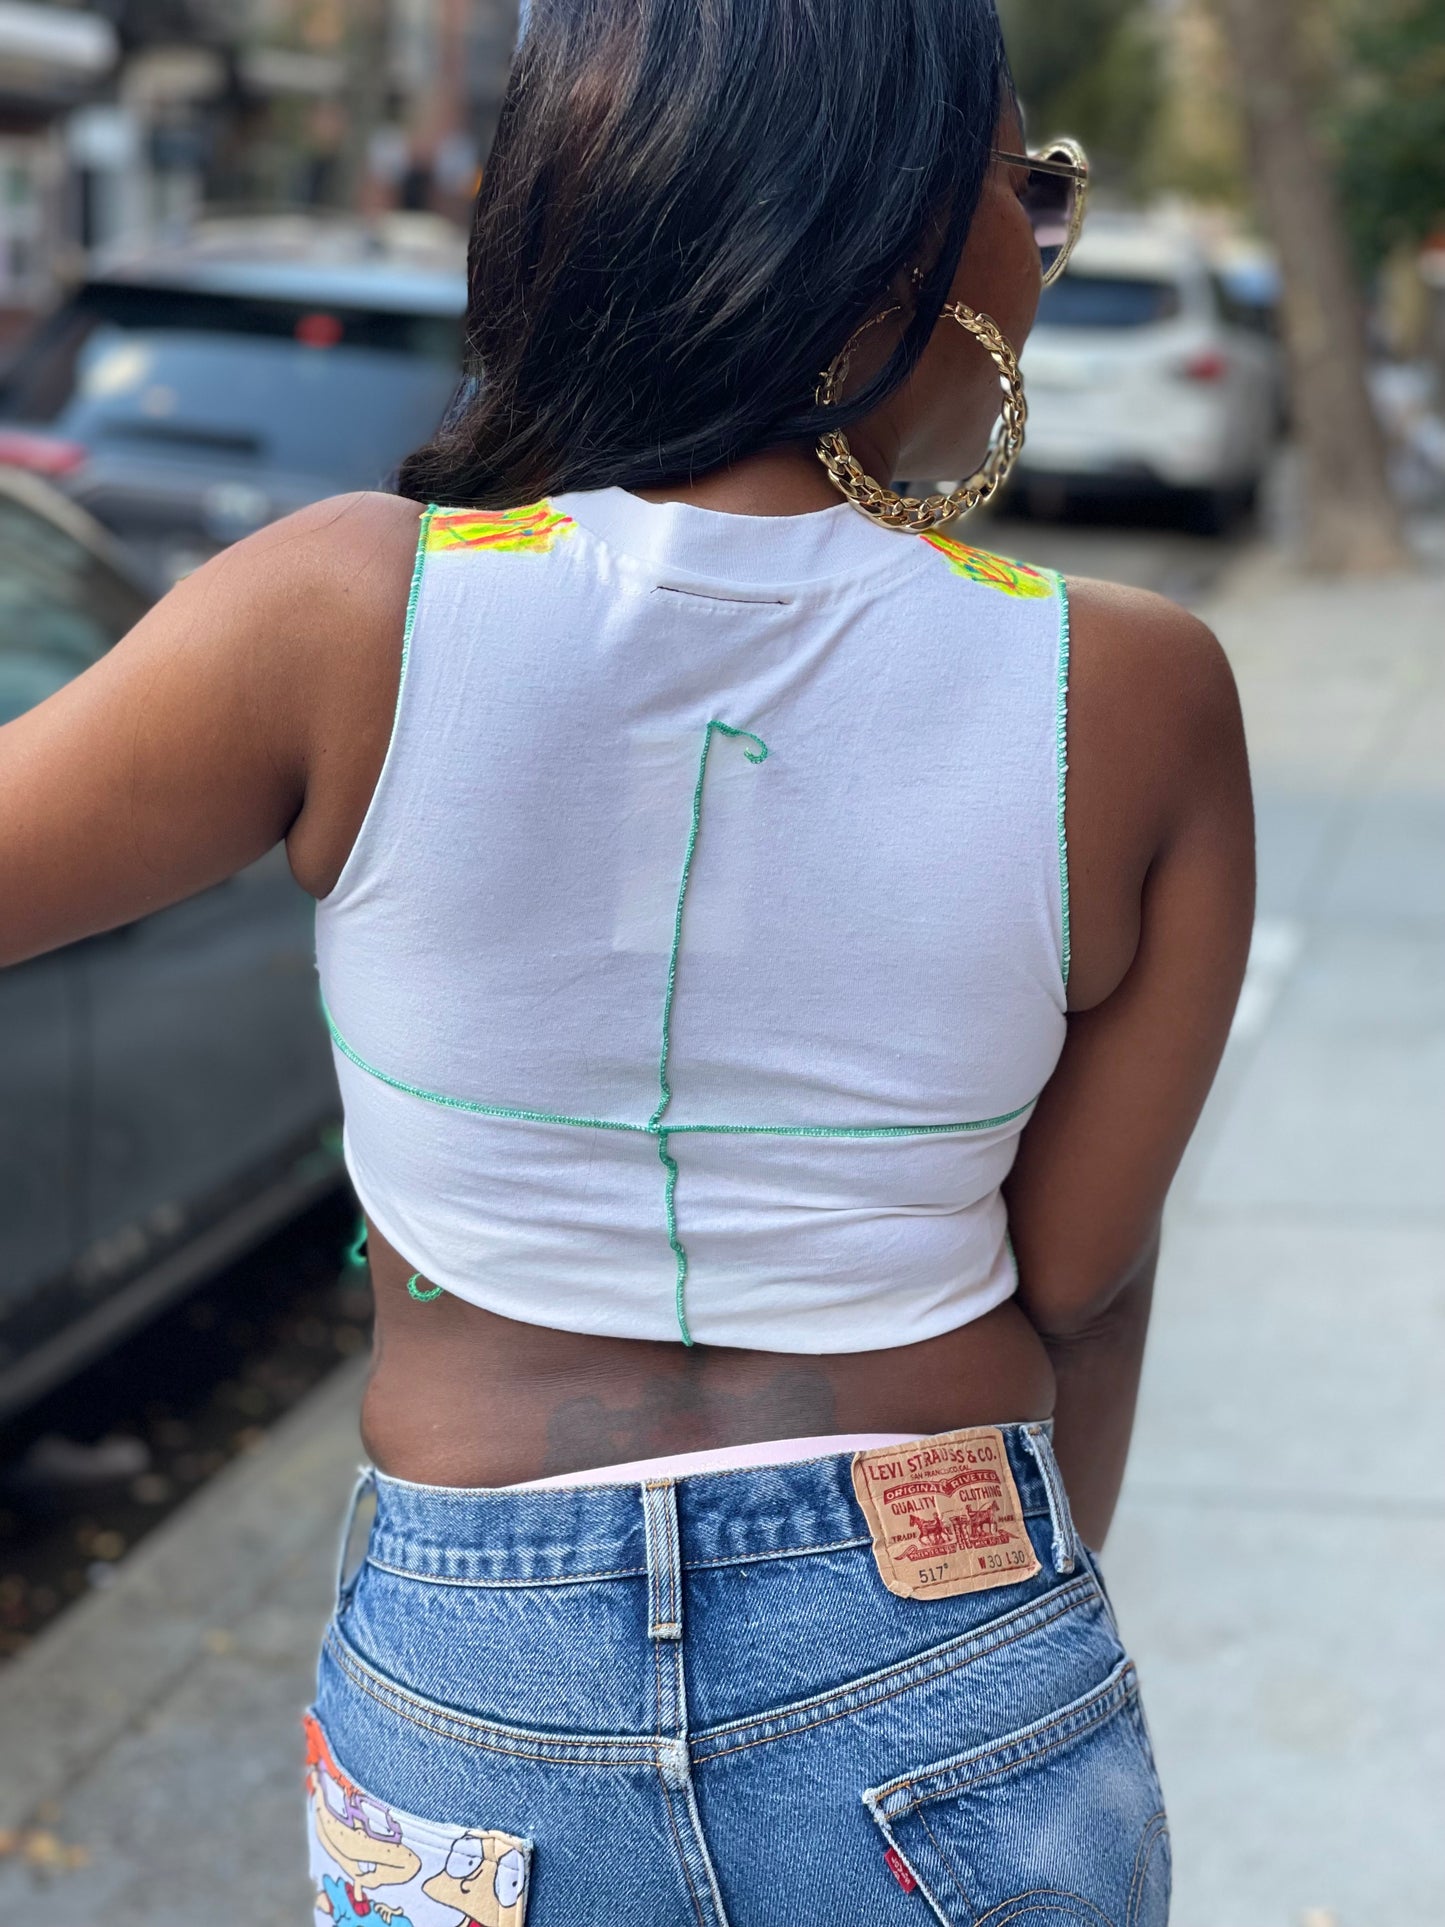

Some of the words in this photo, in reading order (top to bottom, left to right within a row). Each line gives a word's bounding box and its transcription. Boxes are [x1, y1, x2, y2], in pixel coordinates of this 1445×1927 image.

[868, 1462, 904, 1481] LEVI
[907, 1447, 966, 1473] STRAUSS
[967, 1450, 978, 1464] &
[978, 1446, 997, 1461] CO.
[886, 1482, 946, 1500] ORIGINAL
[950, 1472, 997, 1489] RIVETED
[891, 1496, 936, 1516] QUALITY
[959, 1485, 1002, 1502] CLOTHING
[891, 1532, 918, 1543] TRADE
